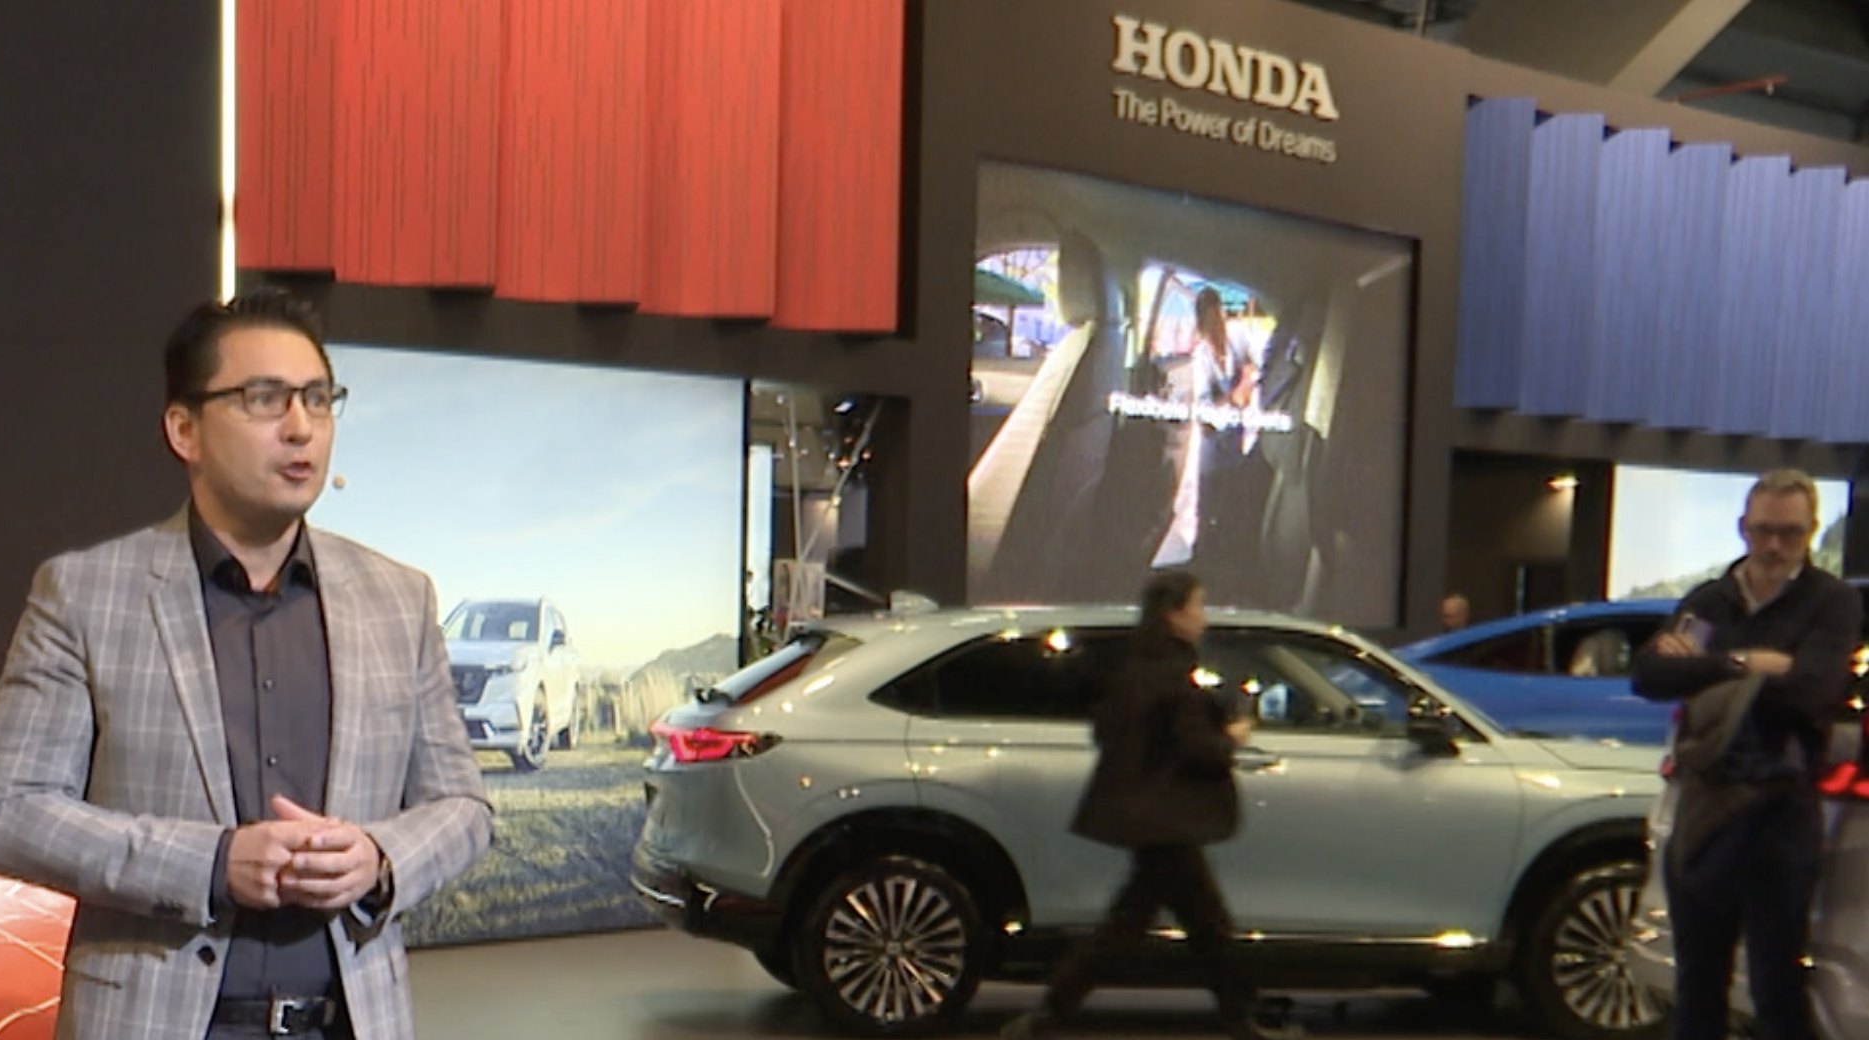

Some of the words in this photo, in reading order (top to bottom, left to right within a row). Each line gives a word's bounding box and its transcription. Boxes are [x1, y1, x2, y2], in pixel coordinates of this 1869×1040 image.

[1111, 15, 1340, 120] HONDA
[1113, 89, 1157, 126] The
[1160, 97, 1228, 140] Power
[1232, 116, 1257, 146] of
[1258, 120, 1336, 163] Dreams
